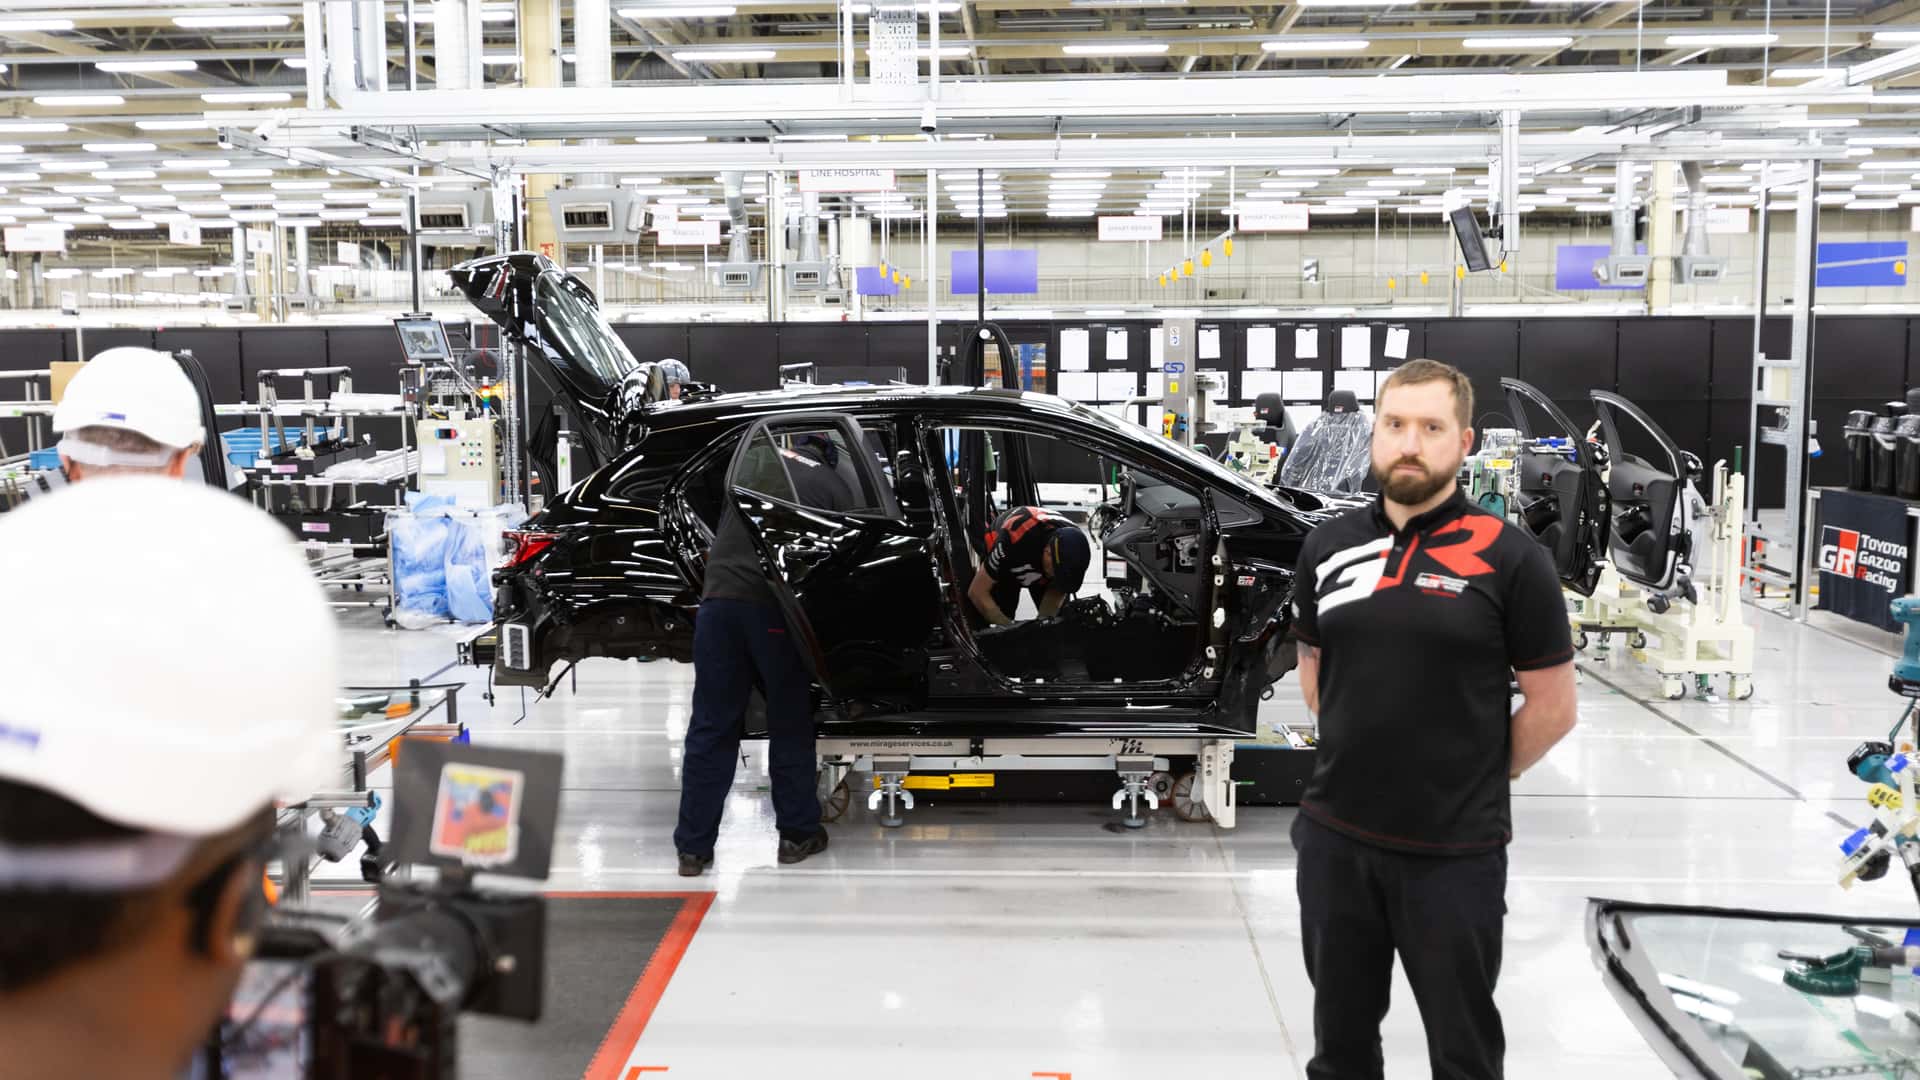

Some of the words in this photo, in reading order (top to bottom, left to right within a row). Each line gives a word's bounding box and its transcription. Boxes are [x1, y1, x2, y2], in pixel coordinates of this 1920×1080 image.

[811, 169, 832, 177] LINE
[834, 168, 881, 177] HOSPITAL
[1861, 534, 1908, 559] TOYOTA
[1819, 544, 1856, 577] GR
[1858, 551, 1901, 573] GAZOO
[1856, 565, 1897, 593] Racing
[849, 740, 953, 748] www.mirageservices.co.uk
